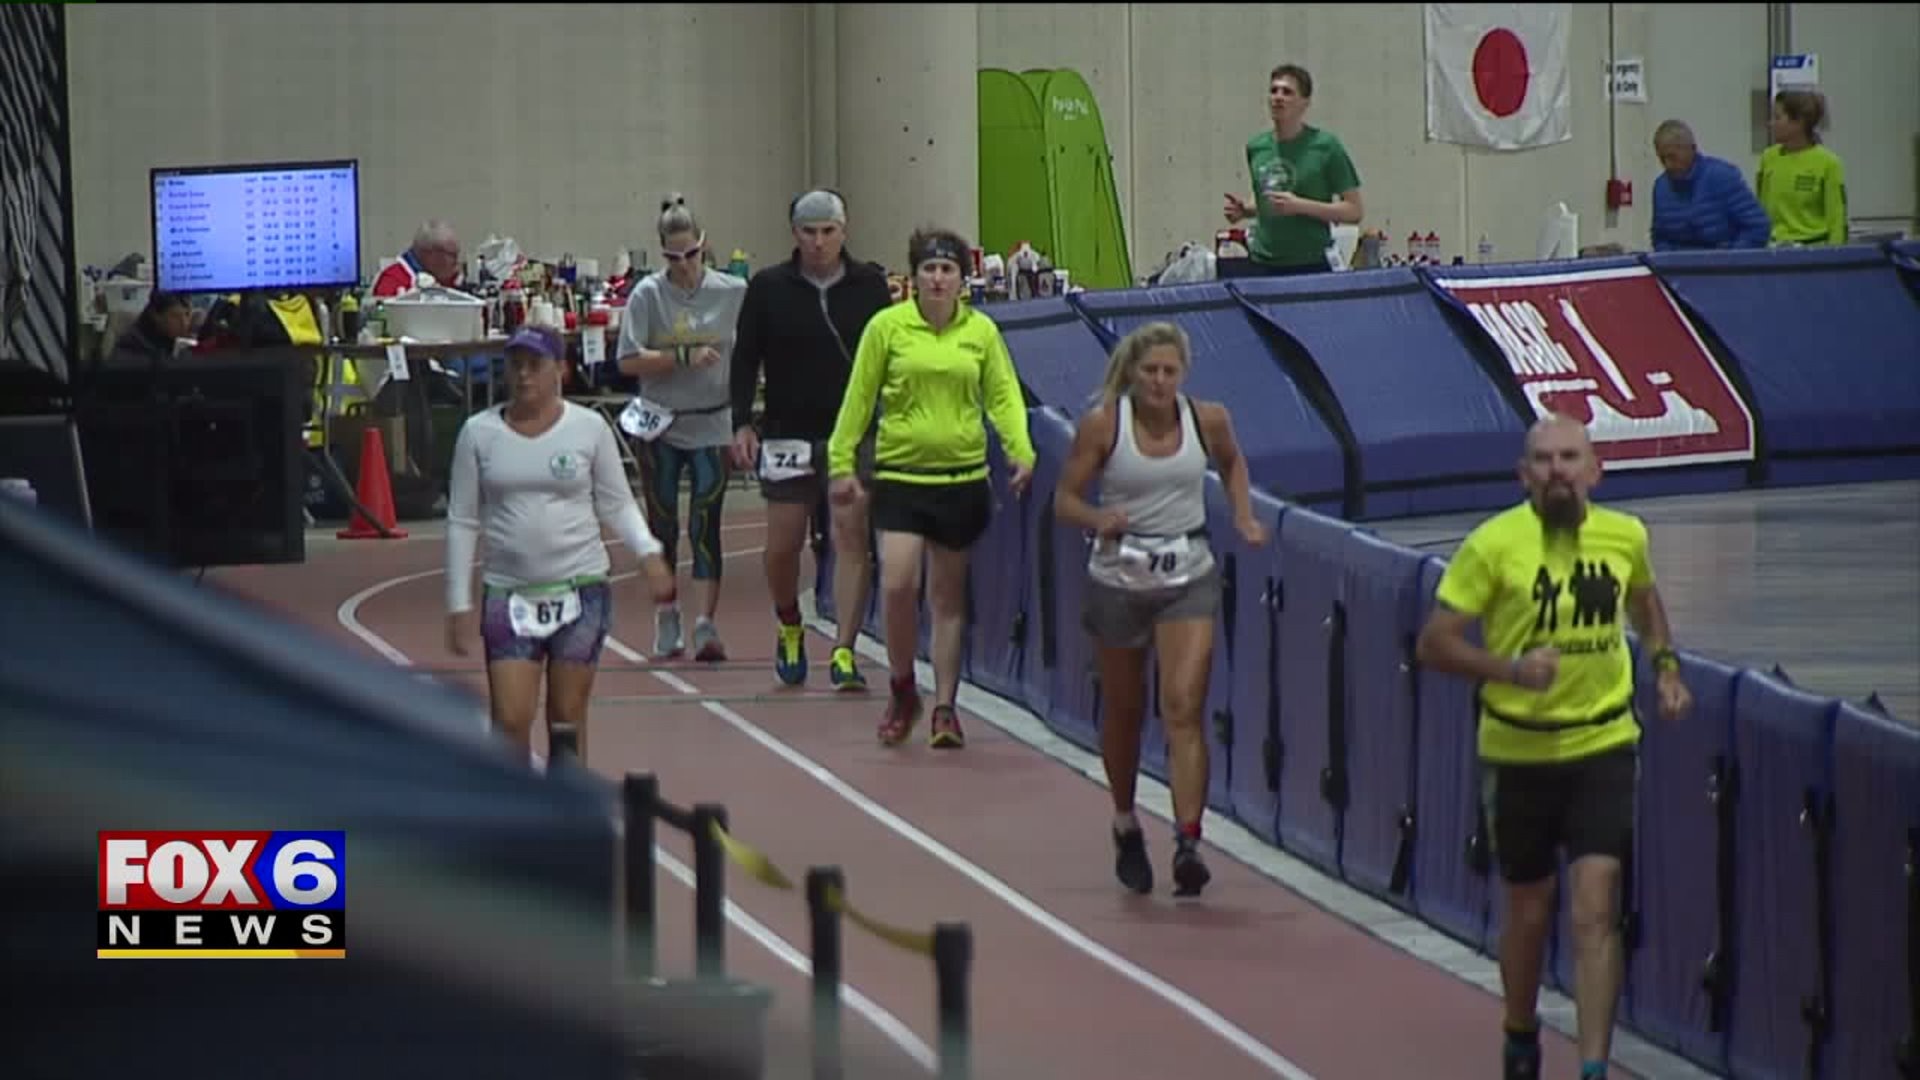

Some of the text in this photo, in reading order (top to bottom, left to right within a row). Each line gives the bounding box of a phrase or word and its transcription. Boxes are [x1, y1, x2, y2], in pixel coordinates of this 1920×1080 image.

[1466, 300, 1578, 375] BASIC
[775, 452, 798, 468] 74
[537, 600, 564, 625] 67
